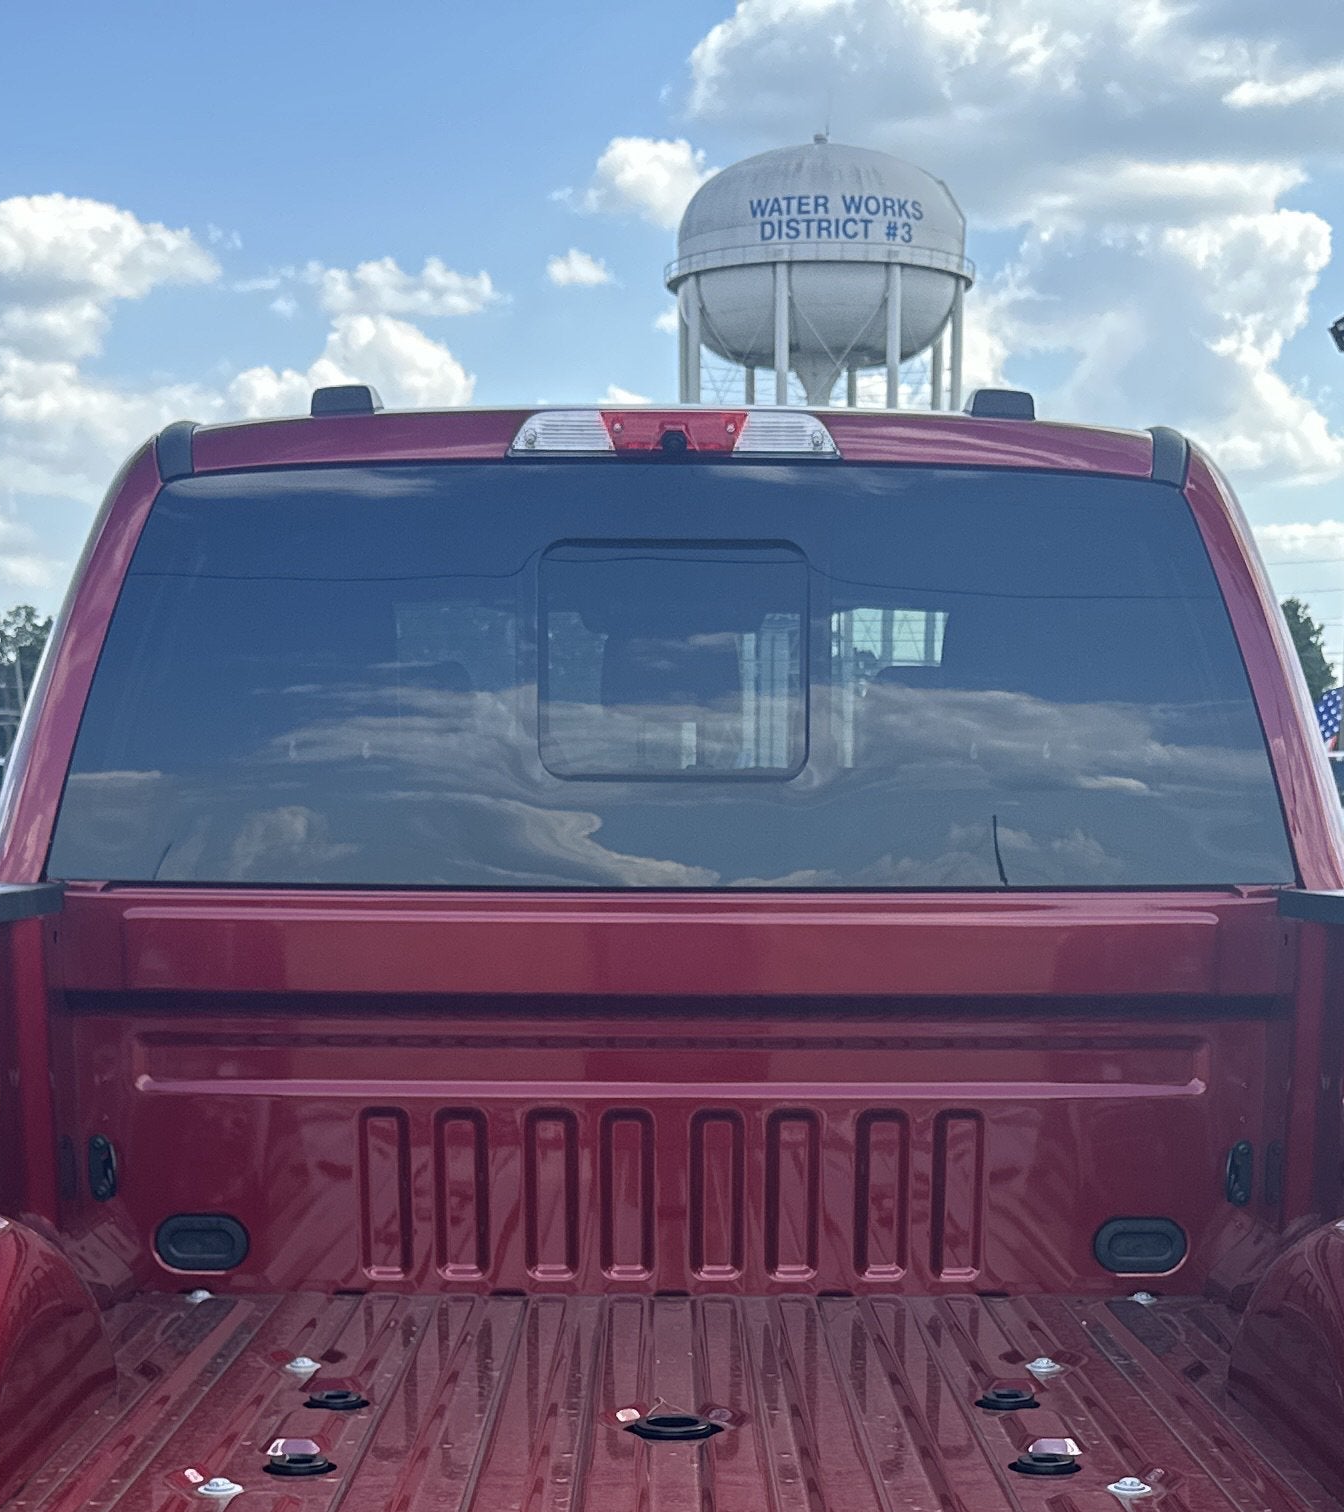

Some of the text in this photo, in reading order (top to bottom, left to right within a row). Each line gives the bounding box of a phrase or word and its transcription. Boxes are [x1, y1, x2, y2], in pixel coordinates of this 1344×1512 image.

[749, 195, 924, 221] WATER WORKS
[759, 218, 913, 244] DISTRICT #3
